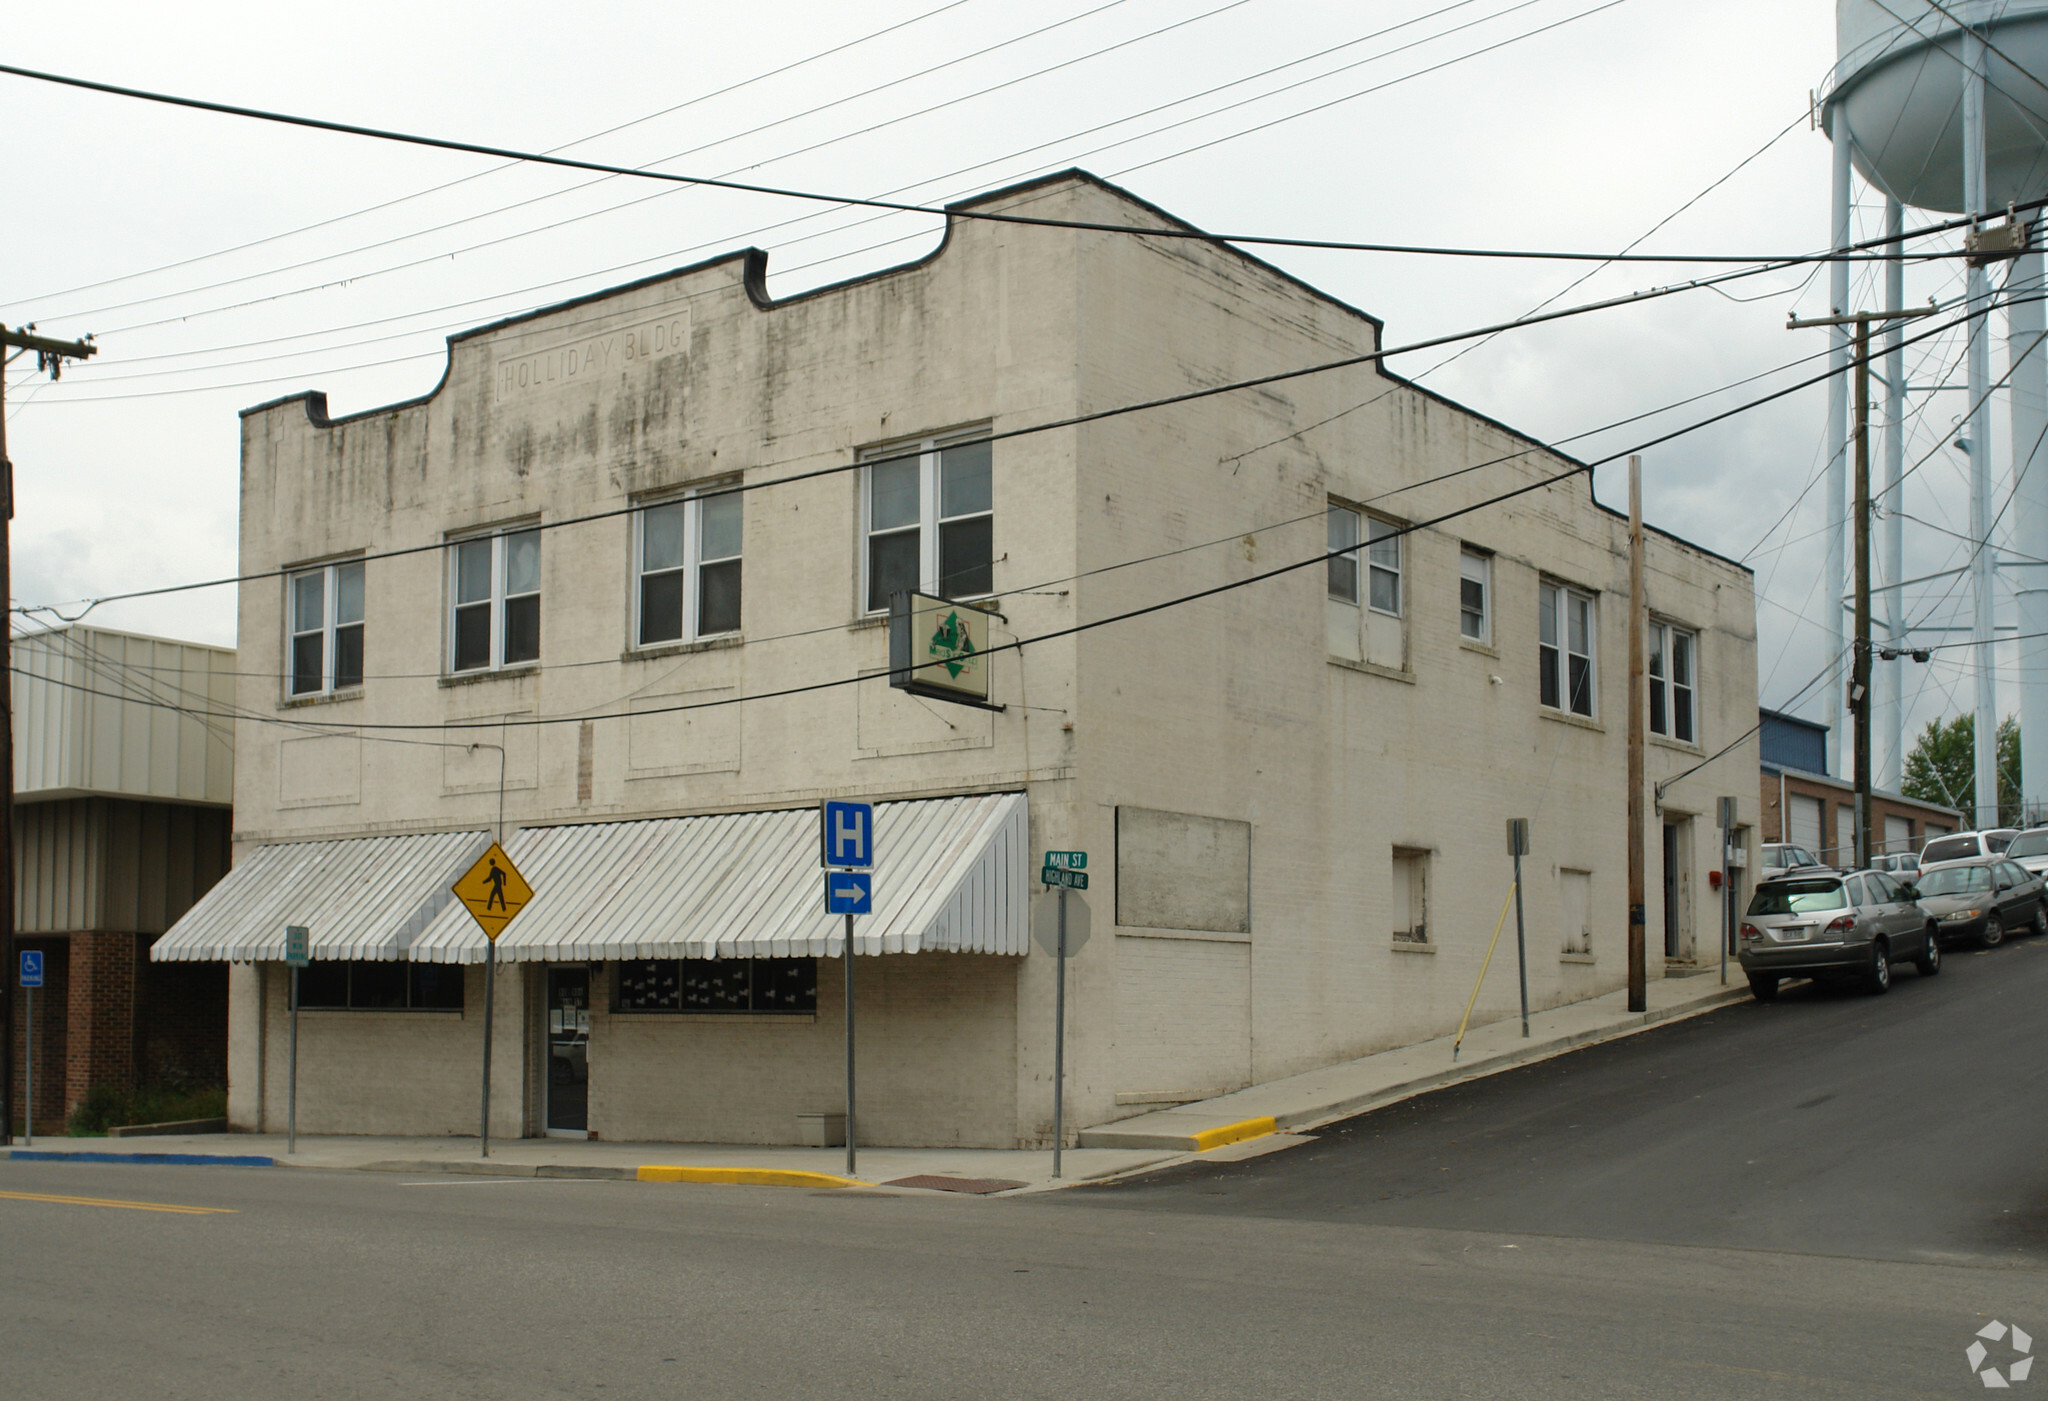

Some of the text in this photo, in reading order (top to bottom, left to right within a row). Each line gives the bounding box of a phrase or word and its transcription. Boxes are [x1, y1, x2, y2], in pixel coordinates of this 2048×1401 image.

[504, 338, 614, 392] HOLLIDAY
[835, 810, 864, 858] H
[1050, 853, 1082, 867] MAIN ST
[1045, 869, 1085, 888] HIGHLAND AVE
